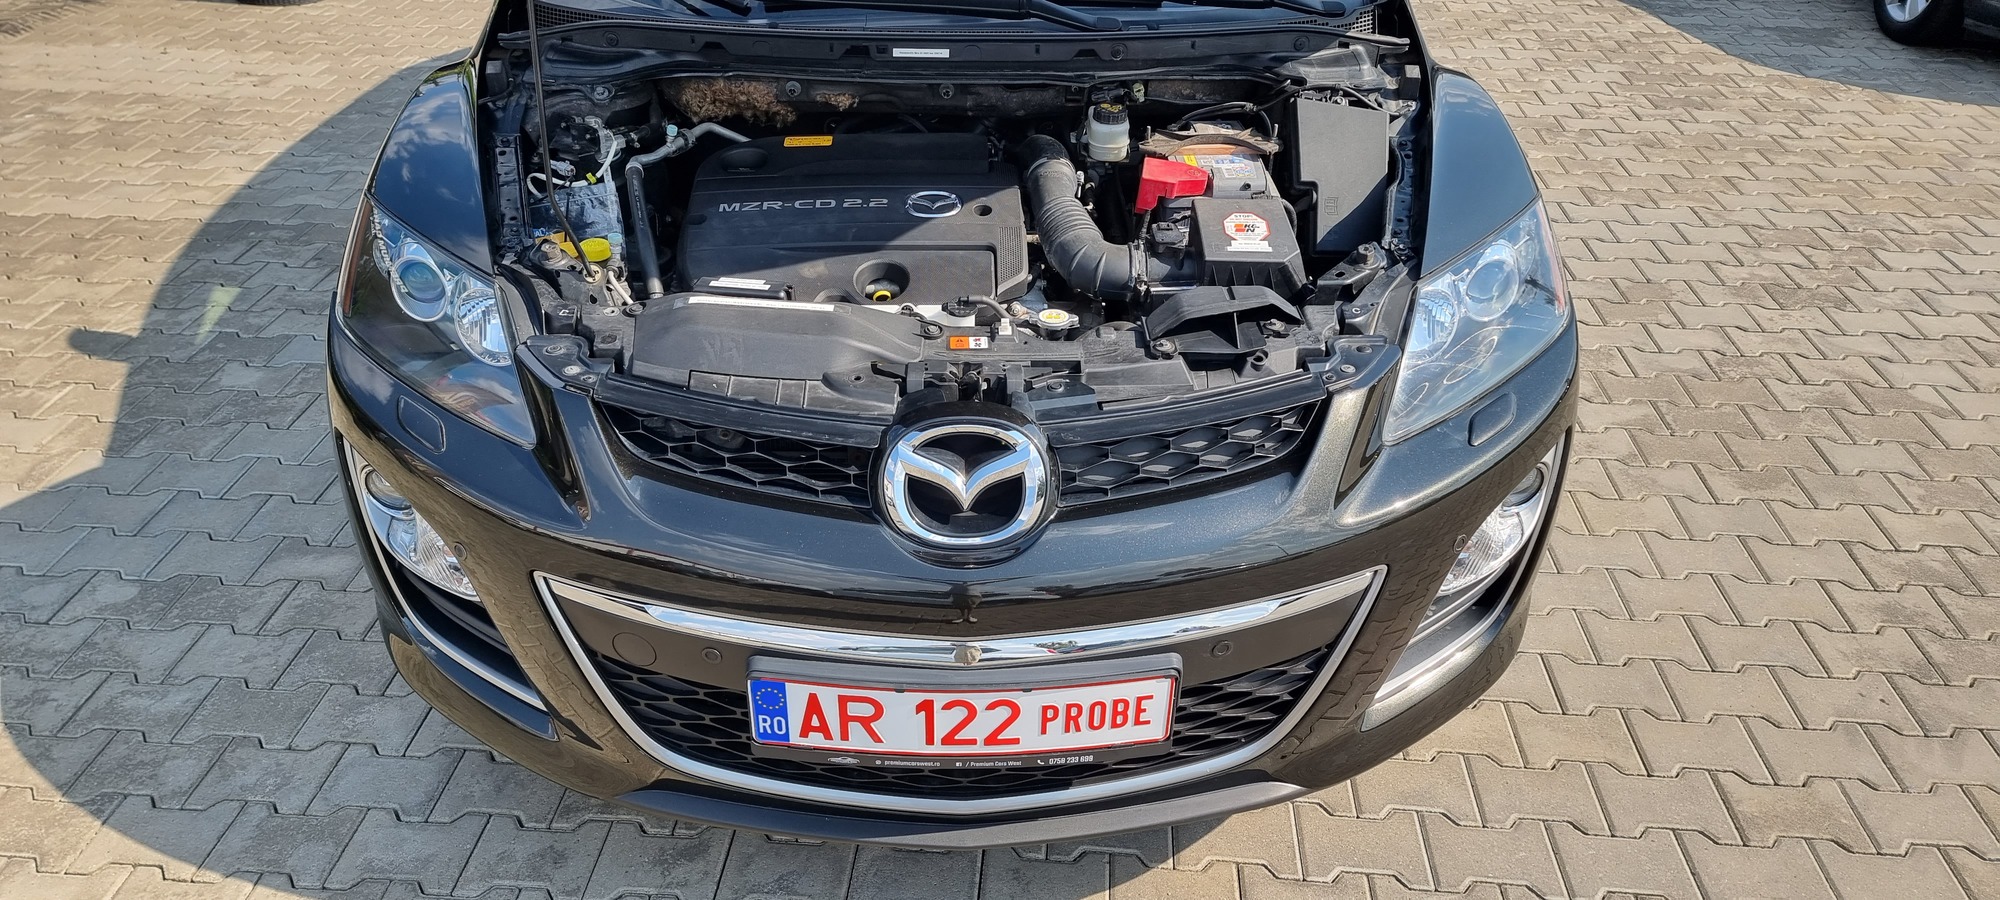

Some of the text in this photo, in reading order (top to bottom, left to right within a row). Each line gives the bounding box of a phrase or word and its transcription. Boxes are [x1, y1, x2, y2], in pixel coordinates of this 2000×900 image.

[718, 198, 888, 212] MZR-CD 2.2
[758, 714, 786, 735] RO
[799, 692, 1153, 746] AR 122 PROBE
